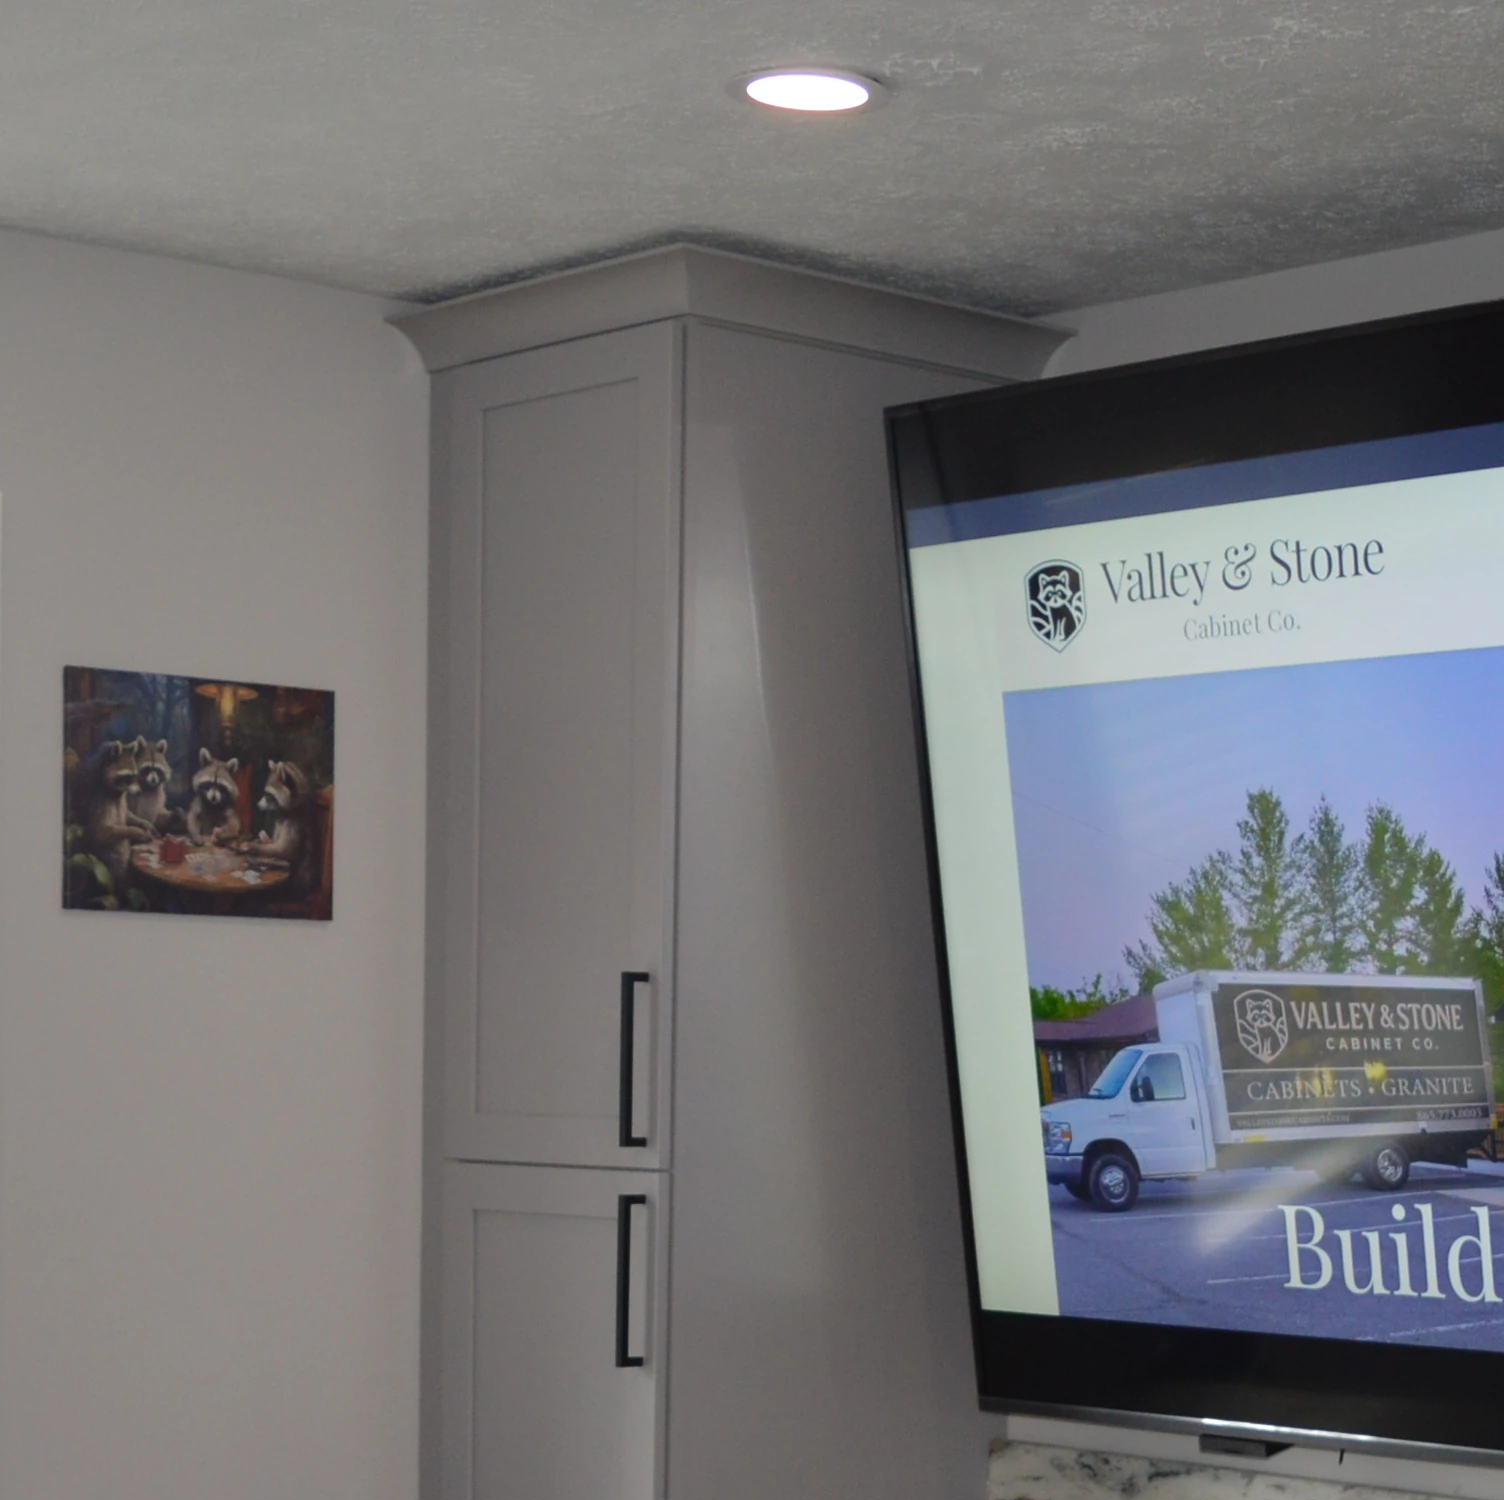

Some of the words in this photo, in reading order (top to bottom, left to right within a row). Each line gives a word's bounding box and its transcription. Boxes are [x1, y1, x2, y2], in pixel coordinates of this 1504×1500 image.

[1101, 550, 1211, 606] Valley
[1221, 543, 1257, 591] &
[1269, 538, 1385, 587] Stone
[1183, 613, 1260, 641] Cabinet
[1268, 608, 1300, 633] Co.
[1289, 1001, 1375, 1030] VALLEY
[1380, 1004, 1395, 1029] &
[1396, 1003, 1464, 1031] STONE
[1326, 1037, 1403, 1050] CABINET
[1412, 1037, 1439, 1050] CO.
[1247, 1079, 1362, 1101] CABINETS
[1381, 1077, 1474, 1096] GRANITE
[1277, 1203, 1503, 1303] Build
